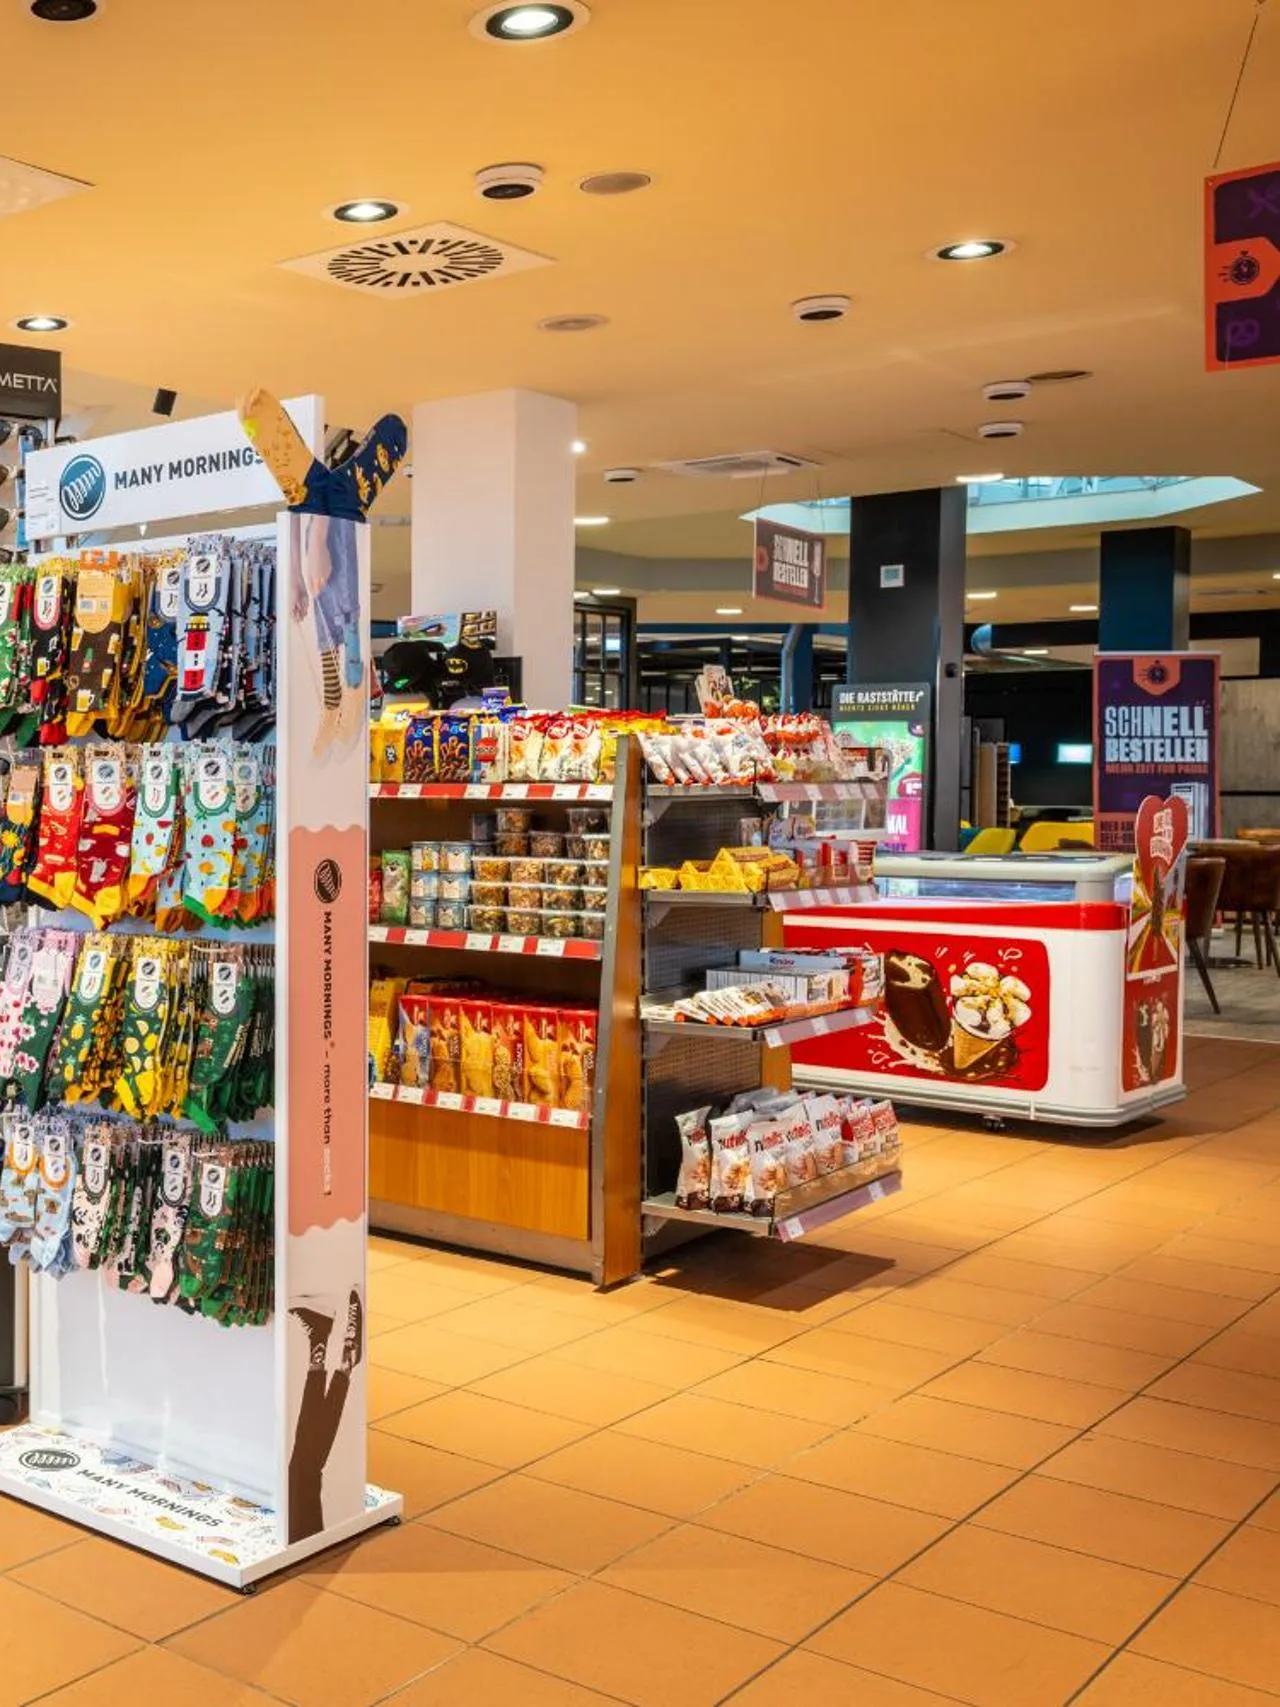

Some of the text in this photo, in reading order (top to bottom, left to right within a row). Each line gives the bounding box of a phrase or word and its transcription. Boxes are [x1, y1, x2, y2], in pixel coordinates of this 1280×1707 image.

[114, 463, 164, 490] MANY
[839, 692, 855, 704] DIE
[439, 722, 468, 736] ABC
[1105, 706, 1208, 736] SCHNELL
[1105, 738, 1208, 762] BESTELLEN
[323, 911, 332, 956] MANY
[323, 958, 332, 1040] MORNINGS
[323, 1063, 331, 1104] more
[323, 1107, 332, 1145] than
[76, 1469, 224, 1527] MANY MORNINGS
